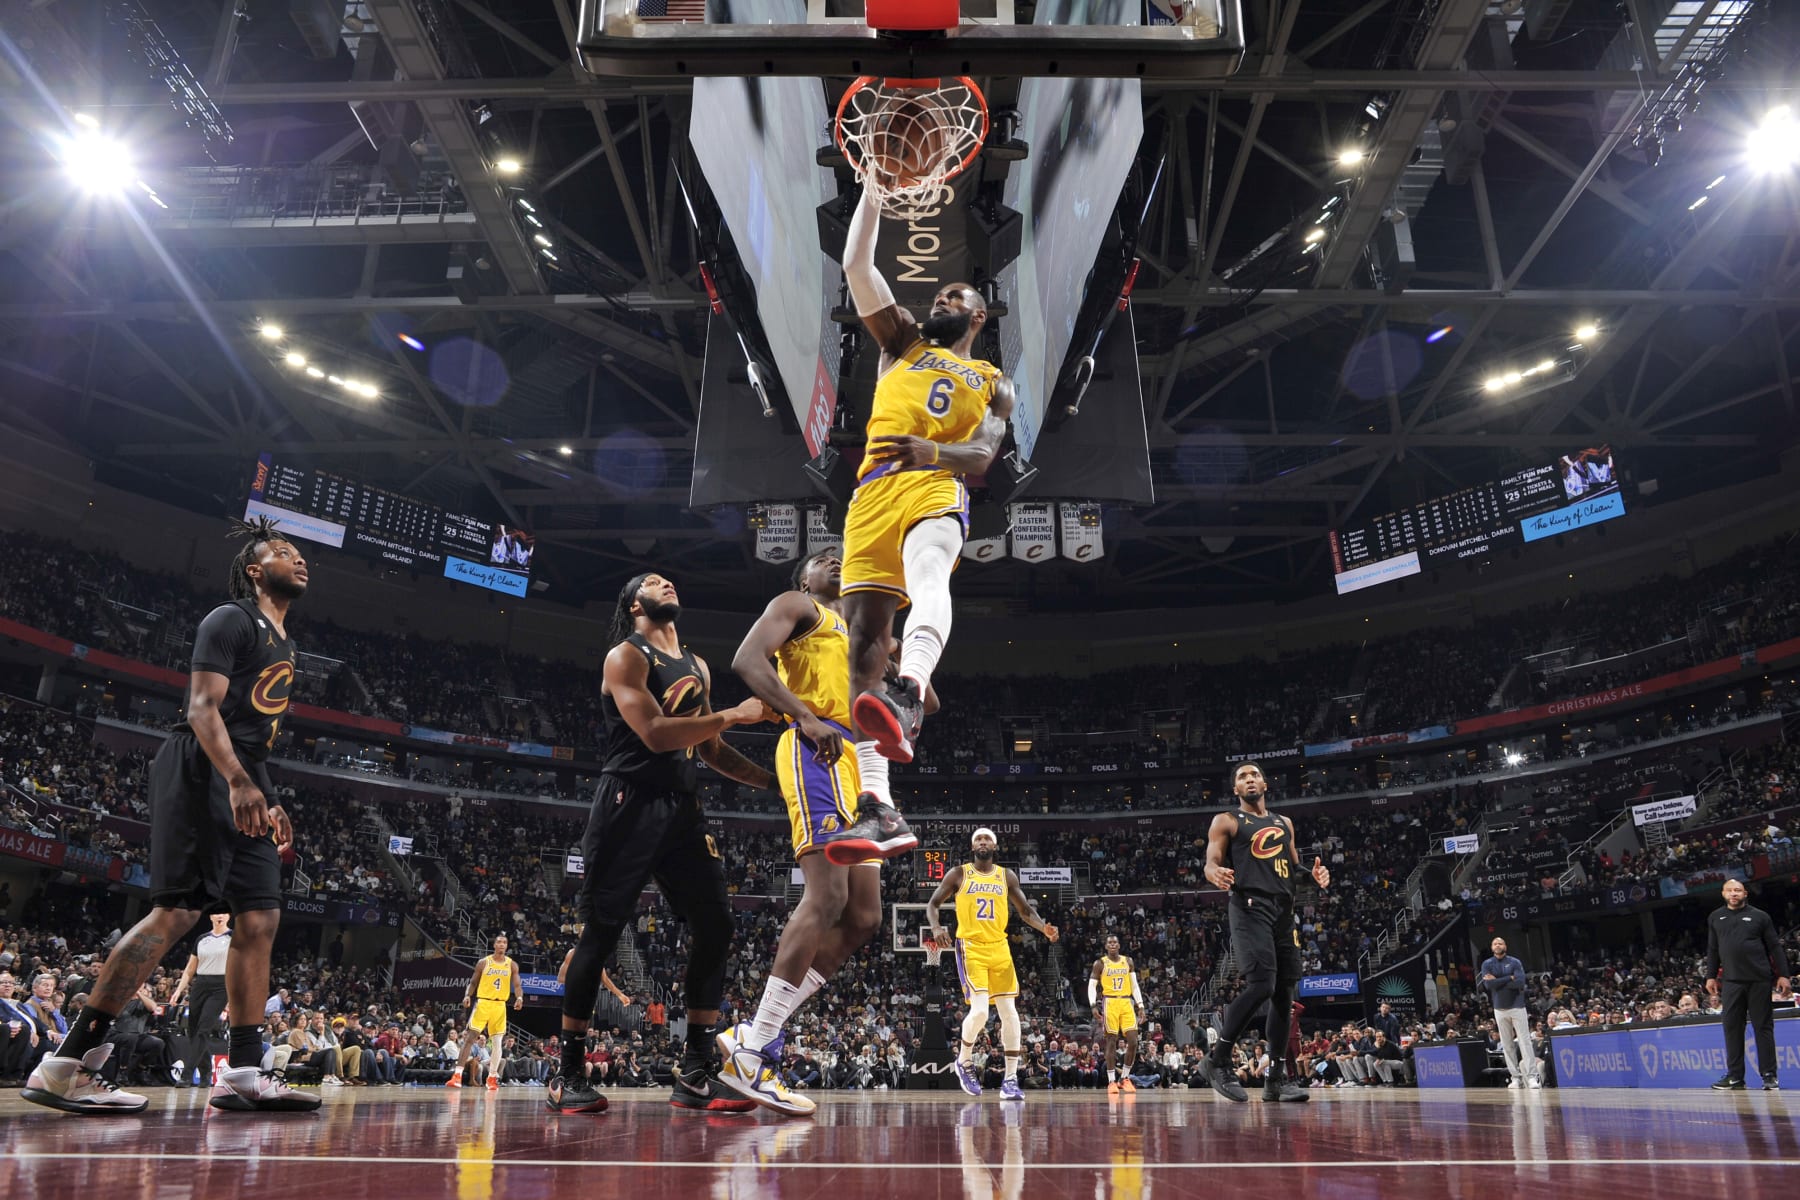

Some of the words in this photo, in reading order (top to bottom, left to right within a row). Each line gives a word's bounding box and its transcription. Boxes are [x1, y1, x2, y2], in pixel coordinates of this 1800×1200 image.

[896, 184, 955, 282] Mortg
[905, 351, 986, 390] LAKERS
[926, 377, 956, 418] 6
[1500, 474, 1521, 486] FAMILY
[1522, 470, 1536, 480] FUN
[1536, 465, 1554, 475] PACK
[1504, 491, 1520, 501] $25
[446, 512, 464, 522] FAMILY
[465, 518, 476, 527] FUN
[477, 522, 491, 530] PACK
[1530, 520, 1548, 531] The
[1550, 515, 1572, 526] King
[1573, 508, 1582, 521] of
[444, 526, 456, 536] $25
[357, 533, 386, 546] DONOVAN
[419, 550, 440, 562] DARIUS
[1429, 543, 1458, 556] DONOVAN
[1492, 526, 1514, 538] DARIUS
[453, 563, 468, 574] The
[469, 568, 486, 584] King
[488, 573, 496, 586] of
[1548, 691, 1617, 714] CHRISTMAS
[1621, 684, 1643, 698] ALE
[1226, 754, 1246, 762] LET
[1009, 765, 1021, 774] 58
[1092, 764, 1118, 772] FOULS
[1644, 812, 1657, 820] Call
[990, 824, 1020, 833] CLUB
[26, 842, 52, 858] ALE
[1251, 826, 1285, 859] C
[925, 852, 947, 862] 9:21
[1528, 850, 1553, 859] Homes
[928, 861, 945, 879] 13
[1274, 858, 1289, 879] 45
[1477, 873, 1506, 882] RCKET
[966, 881, 1003, 896] LAKERS
[287, 900, 325, 914] BLOCKS
[976, 898, 995, 920] 21
[1503, 907, 1518, 920] 65
[1612, 890, 1626, 904] 58
[348, 908, 354, 920] 1
[1106, 968, 1128, 976] LAKERS
[402, 975, 472, 990] SHERWIN-WILLIAM
[493, 978, 502, 990] 4
[518, 976, 562, 990] rstEnergy
[1112, 977, 1123, 990] 17
[1303, 978, 1354, 989] FirstEnergy
[1429, 1061, 1460, 1076] FANDUEL
[1578, 1052, 1631, 1072] FANDUEL
